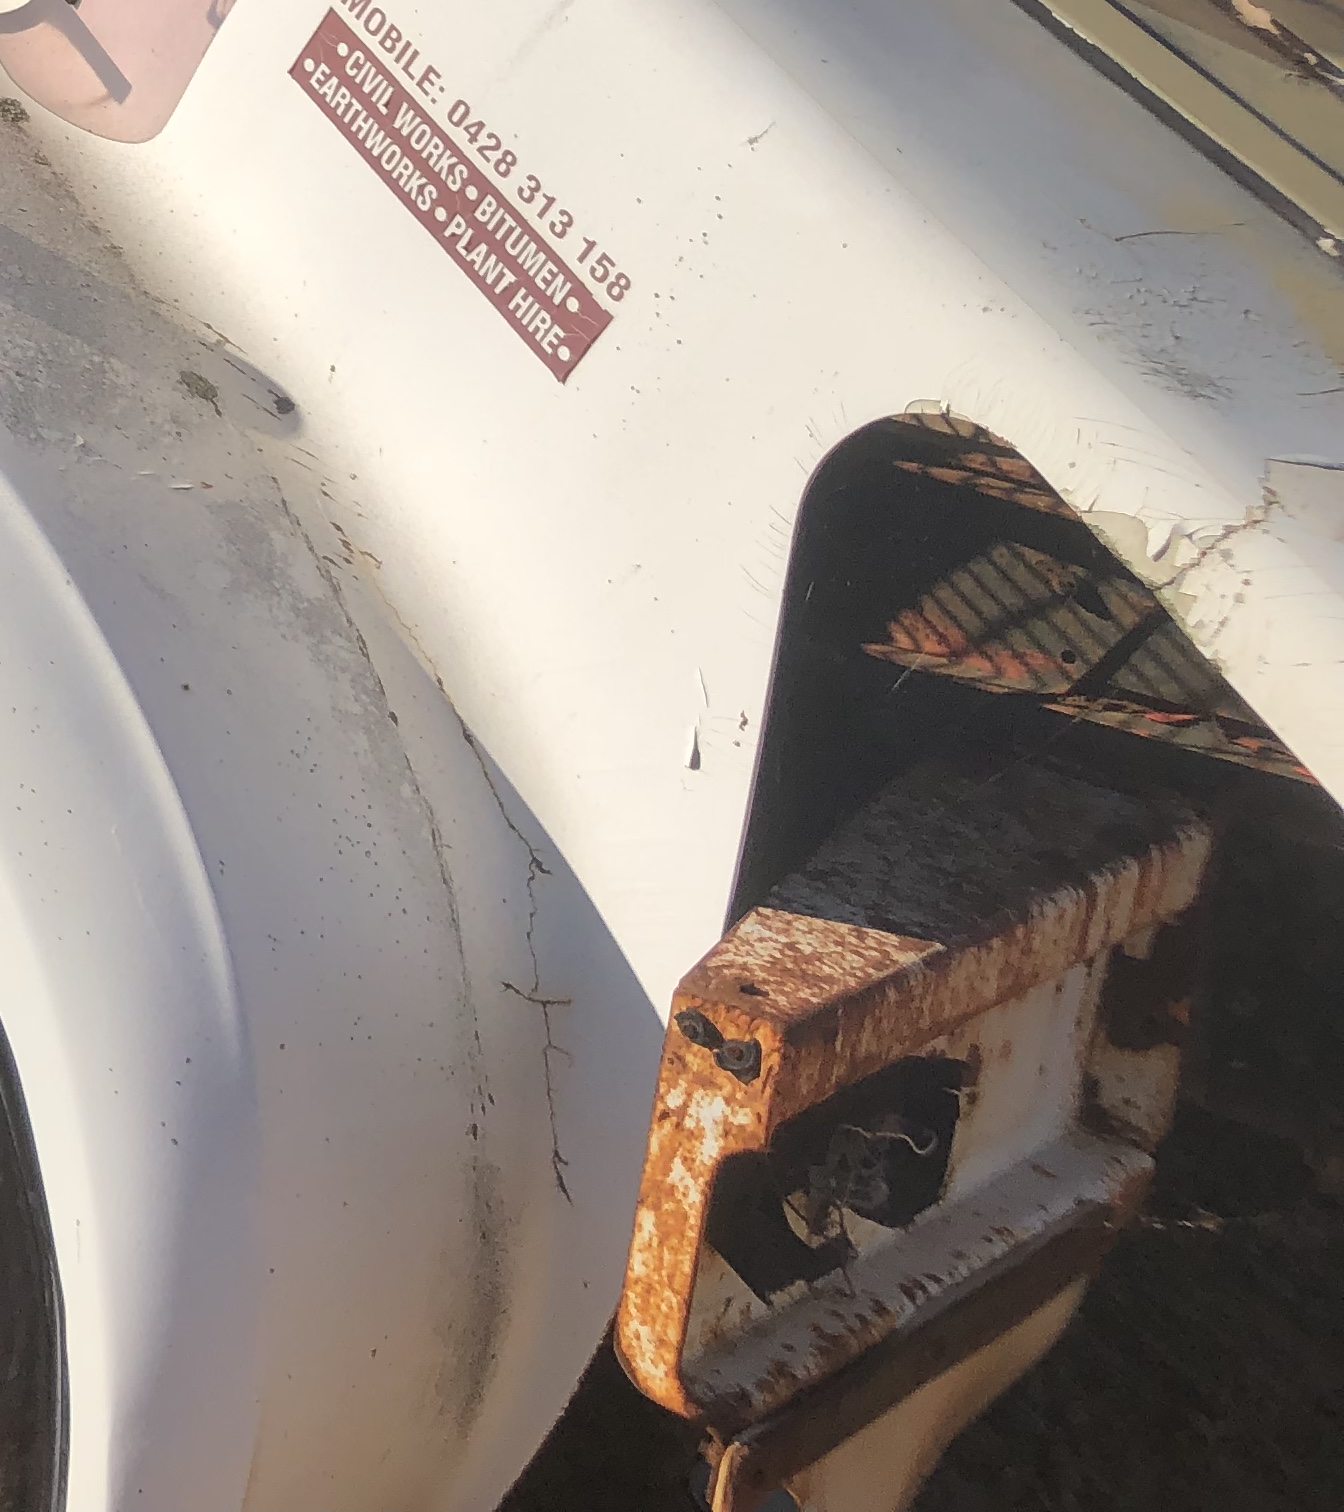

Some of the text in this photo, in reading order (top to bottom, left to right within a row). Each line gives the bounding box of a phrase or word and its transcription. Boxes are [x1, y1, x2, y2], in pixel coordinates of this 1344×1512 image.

[308, 61, 567, 355] EARTHWORKS PLANT HIRE
[344, 49, 573, 306] CIVIL WORKS BITUMEN
[446, 98, 518, 179] 0428
[516, 173, 575, 240] 313
[576, 236, 632, 302] 158
